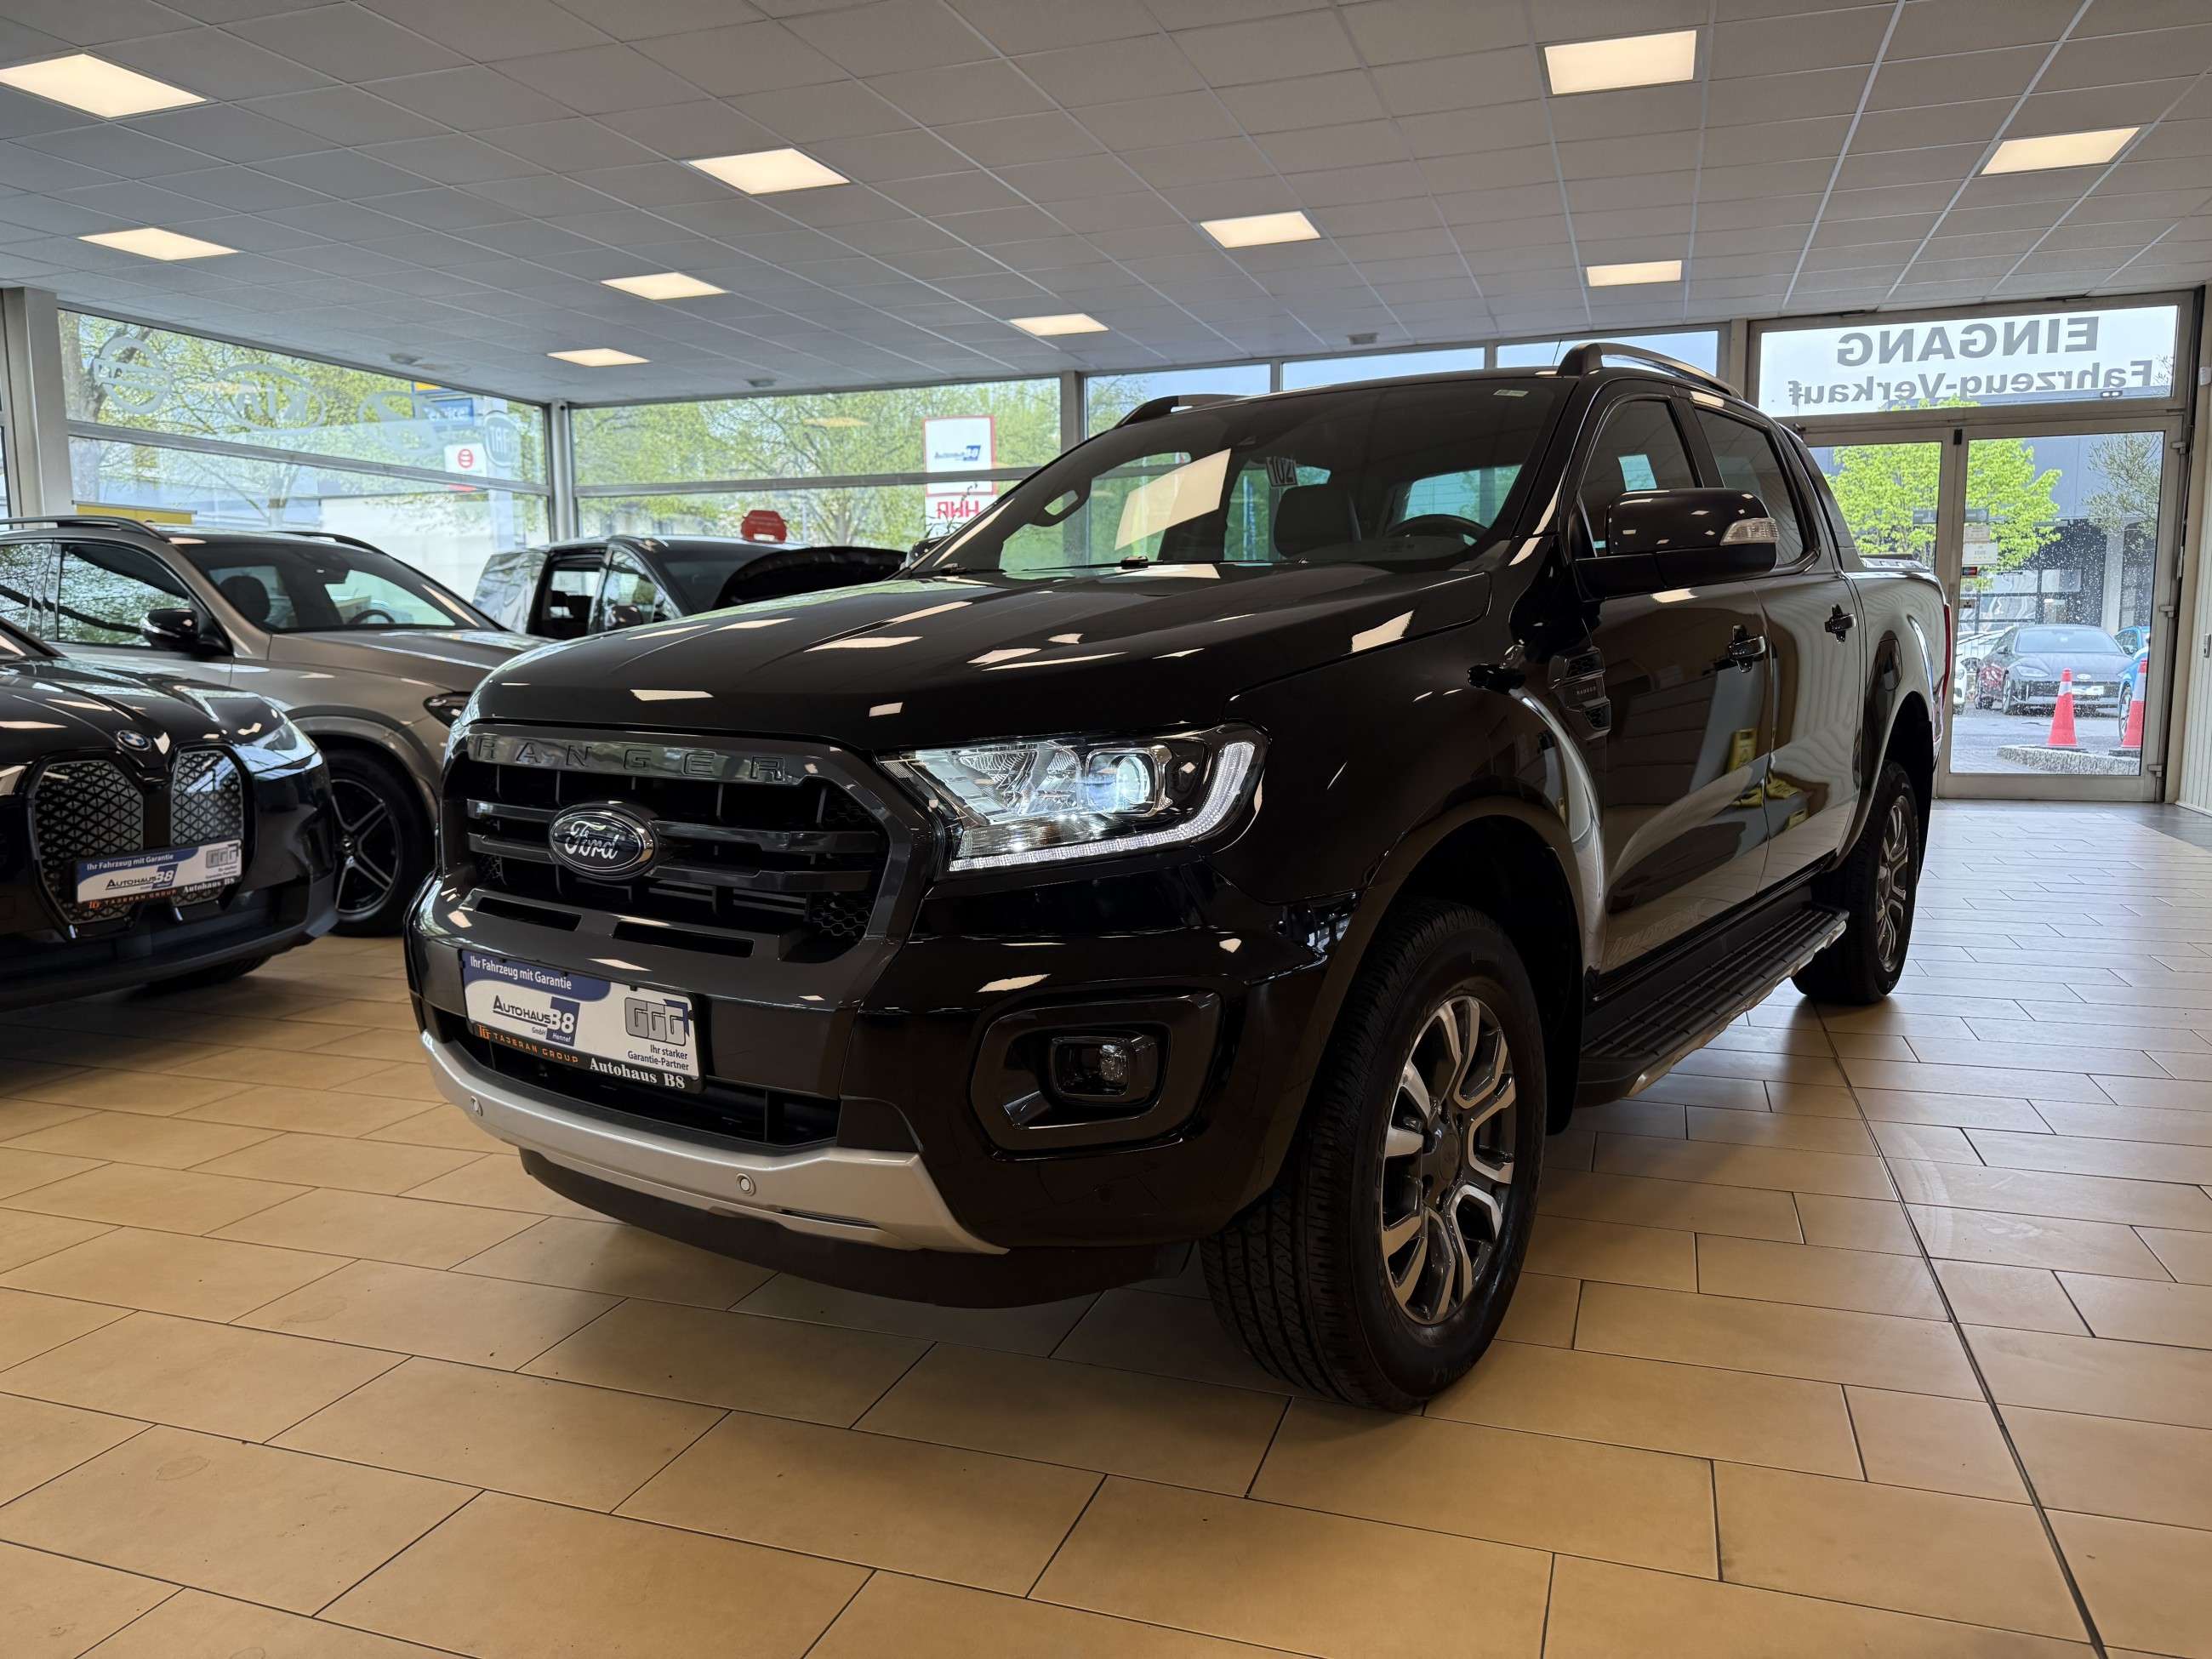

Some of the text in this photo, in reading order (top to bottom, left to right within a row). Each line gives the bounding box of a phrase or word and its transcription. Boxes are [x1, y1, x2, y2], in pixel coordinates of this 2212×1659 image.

[478, 735, 786, 783] RANGER
[565, 820, 619, 859] Ford
[99, 860, 132, 869] Fahrzeug
[145, 853, 174, 863] Garantie
[470, 955, 572, 989] Ihr Fahrzeug mit Garantie
[542, 1047, 579, 1063] GROUP
[627, 1051, 689, 1071] Garantie-Partner
[650, 1044, 688, 1060] Ihr starker
[590, 1057, 686, 1089] Autohaus B8
